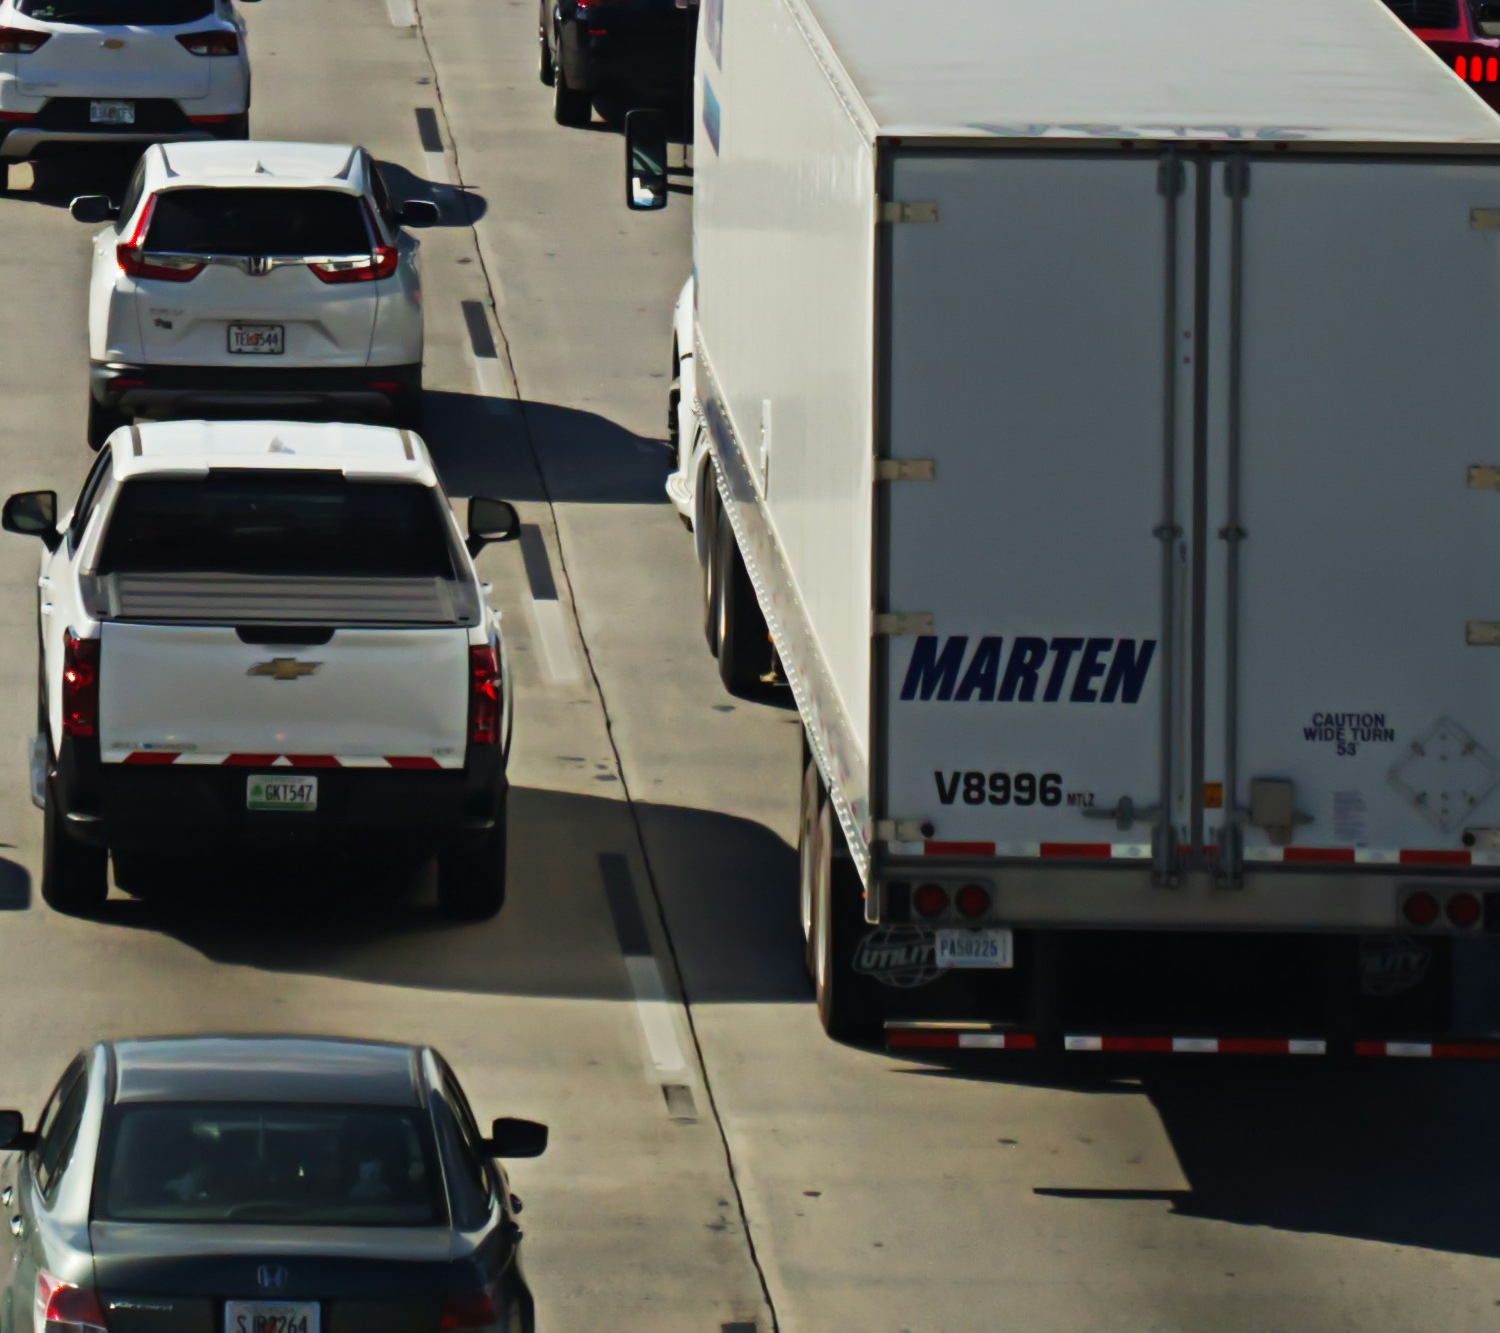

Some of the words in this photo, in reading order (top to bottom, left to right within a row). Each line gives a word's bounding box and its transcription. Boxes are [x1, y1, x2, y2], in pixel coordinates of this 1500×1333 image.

[900, 636, 1157, 703] MARTEN
[1312, 713, 1385, 727] CAUTION
[1303, 728, 1345, 741] WIDE
[1351, 728, 1394, 741] TURN
[265, 784, 312, 801] GKT547
[934, 771, 1063, 807] V8996
[1067, 793, 1094, 807] MTLZ
[860, 945, 935, 969] UTILIT
